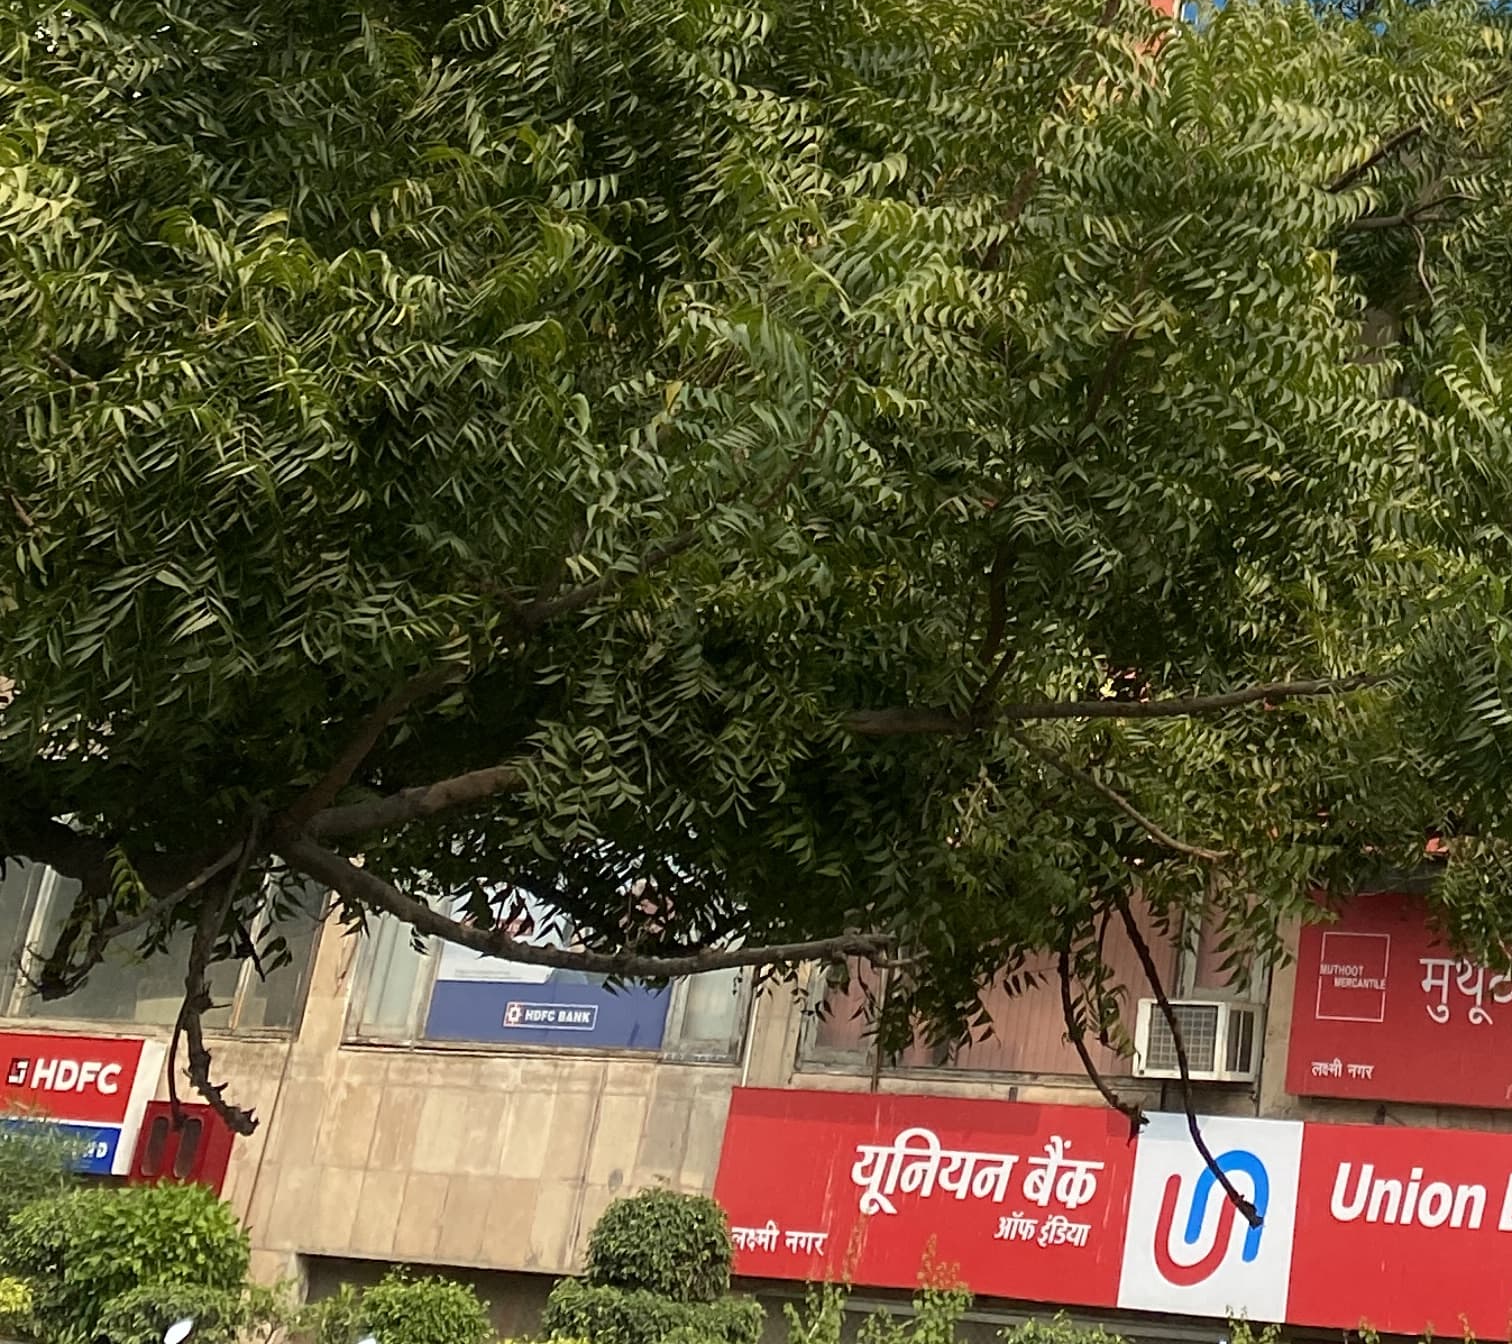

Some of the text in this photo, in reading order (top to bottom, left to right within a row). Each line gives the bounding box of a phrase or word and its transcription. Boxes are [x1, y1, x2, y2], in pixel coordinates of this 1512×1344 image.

[1320, 963, 1364, 977] MUTHOOT
[1334, 977, 1386, 990] MERCANTILE
[524, 1008, 591, 1024] HDFC BANK
[30, 1058, 122, 1095] HDFC
[1347, 1062, 1375, 1081] नगर
[850, 1127, 1105, 1215] यूनियन बैंक
[1329, 1161, 1488, 1230] Union
[730, 1219, 828, 1256] लक्ष्मी नगर
[994, 1211, 1091, 1249] ऑफ इंडिया
